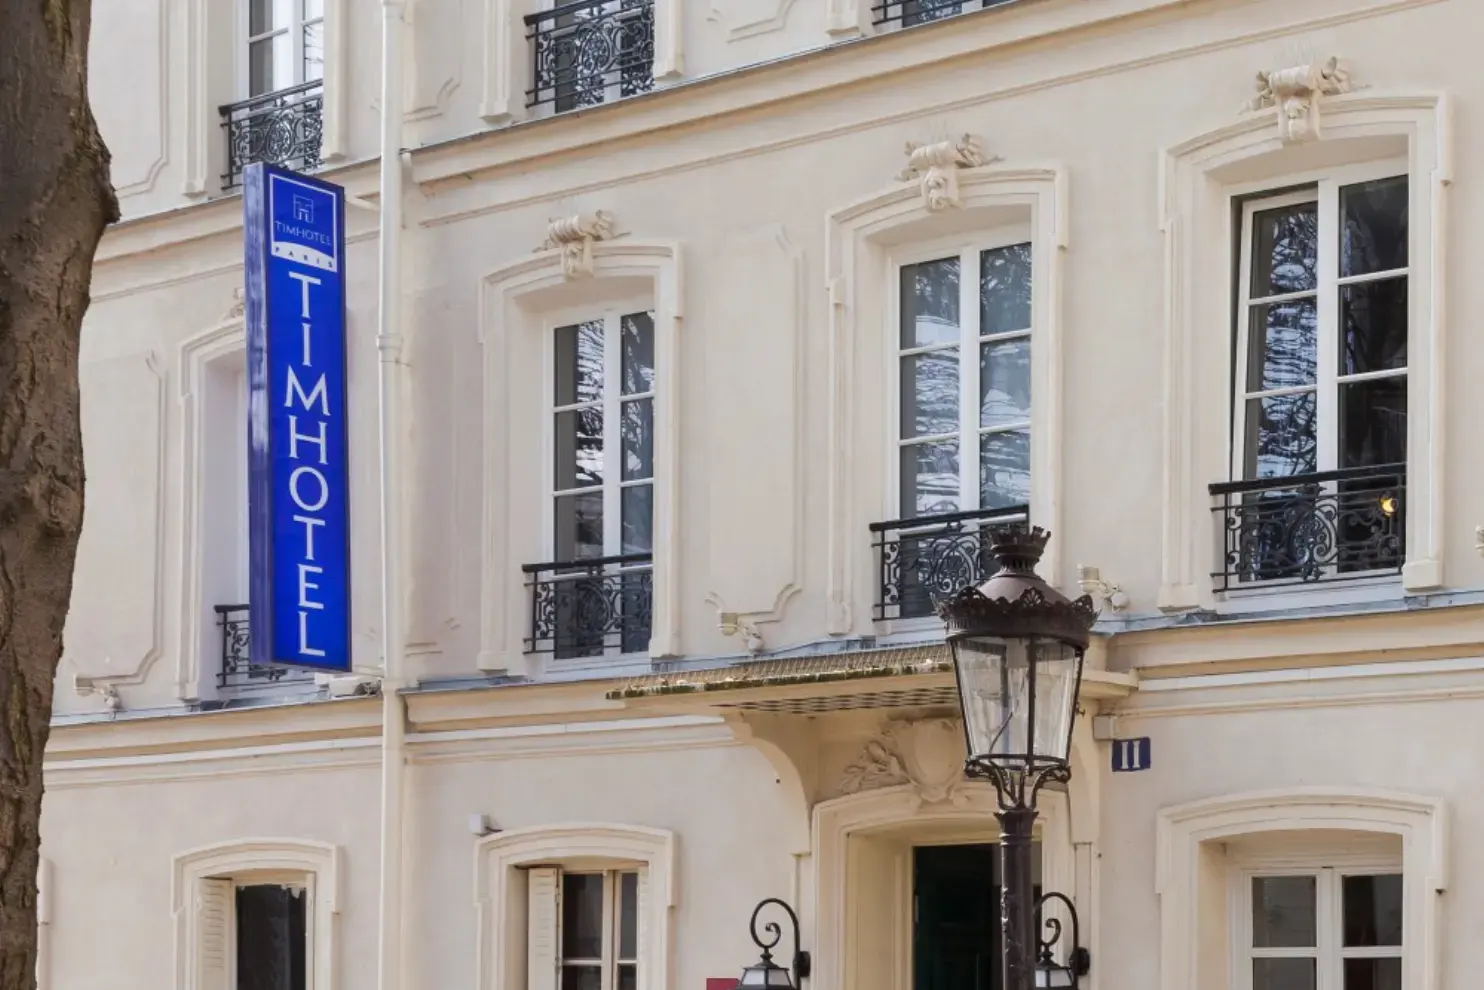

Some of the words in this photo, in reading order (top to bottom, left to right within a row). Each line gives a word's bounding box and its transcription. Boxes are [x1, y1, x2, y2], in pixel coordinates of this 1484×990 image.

[275, 220, 333, 246] TIMHOTEL
[275, 246, 334, 268] PARIS
[284, 270, 331, 658] TIMHOTEL
[1120, 740, 1141, 769] 11
